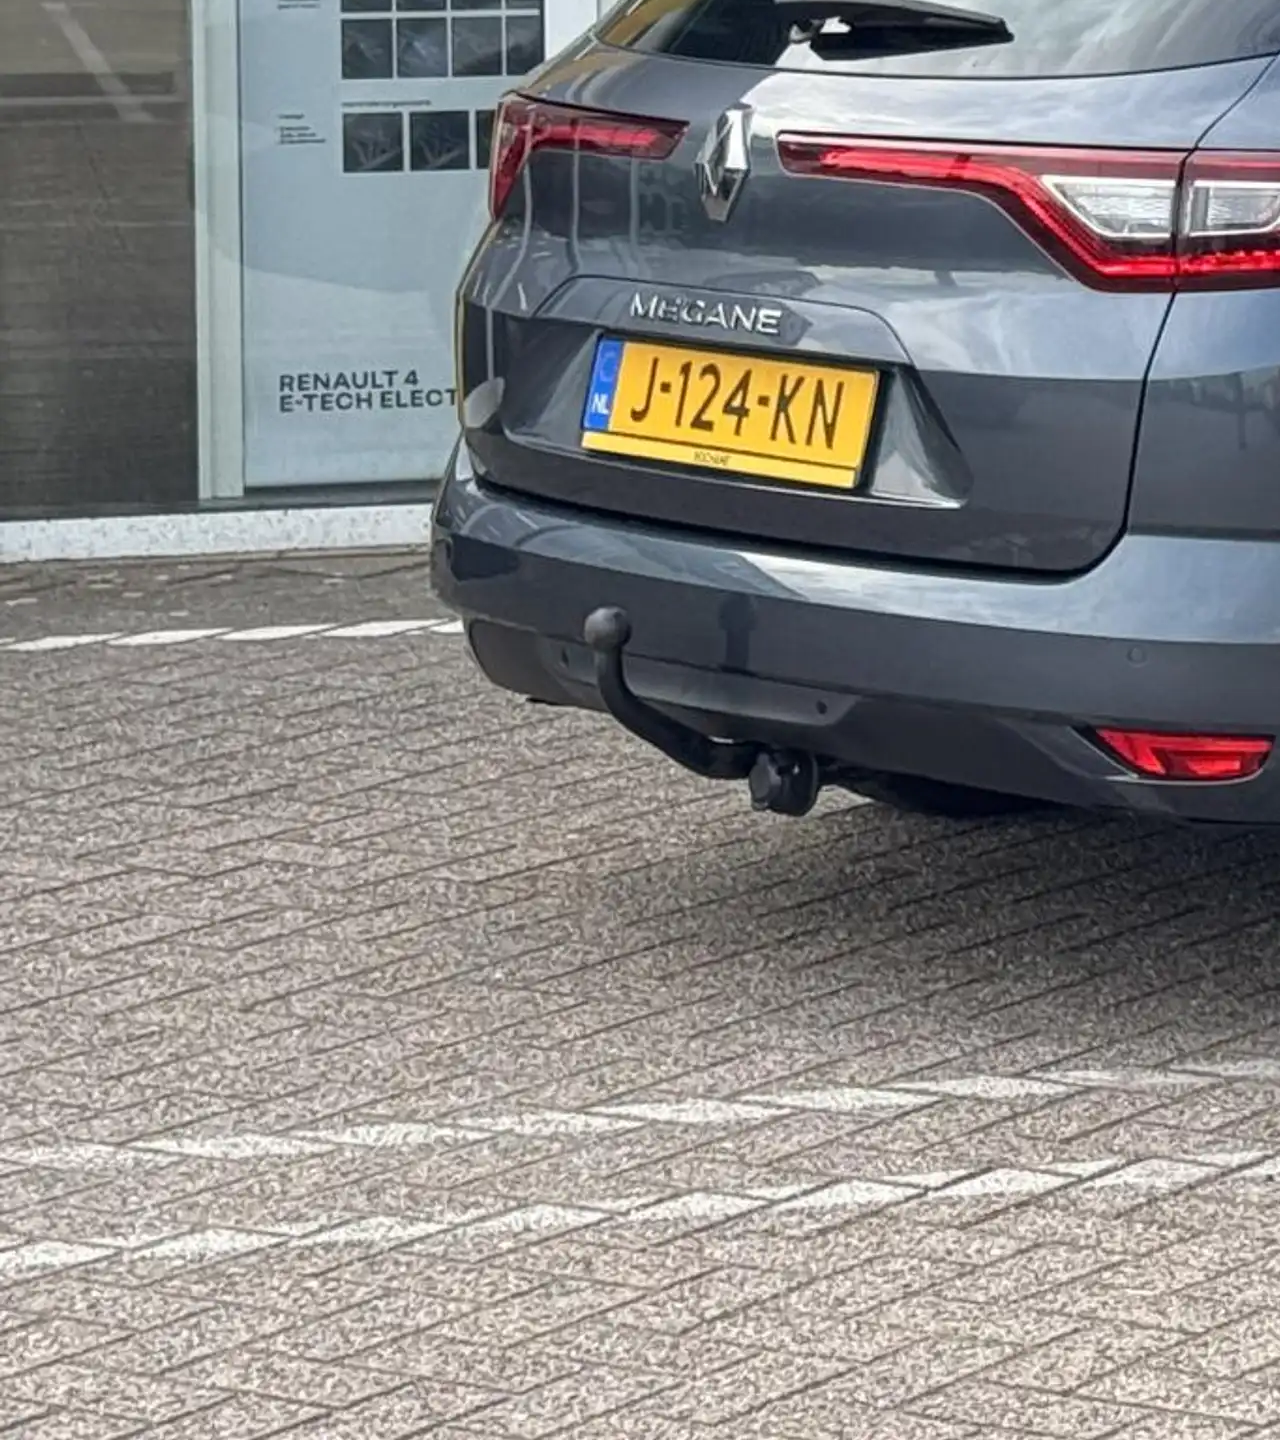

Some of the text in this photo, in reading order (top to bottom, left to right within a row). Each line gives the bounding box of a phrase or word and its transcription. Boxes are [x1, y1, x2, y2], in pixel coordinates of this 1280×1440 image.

[279, 369, 419, 392] RENAULT 4
[279, 391, 373, 413] E-TECH
[592, 393, 611, 416] NL
[630, 357, 845, 450] J-124-KN
